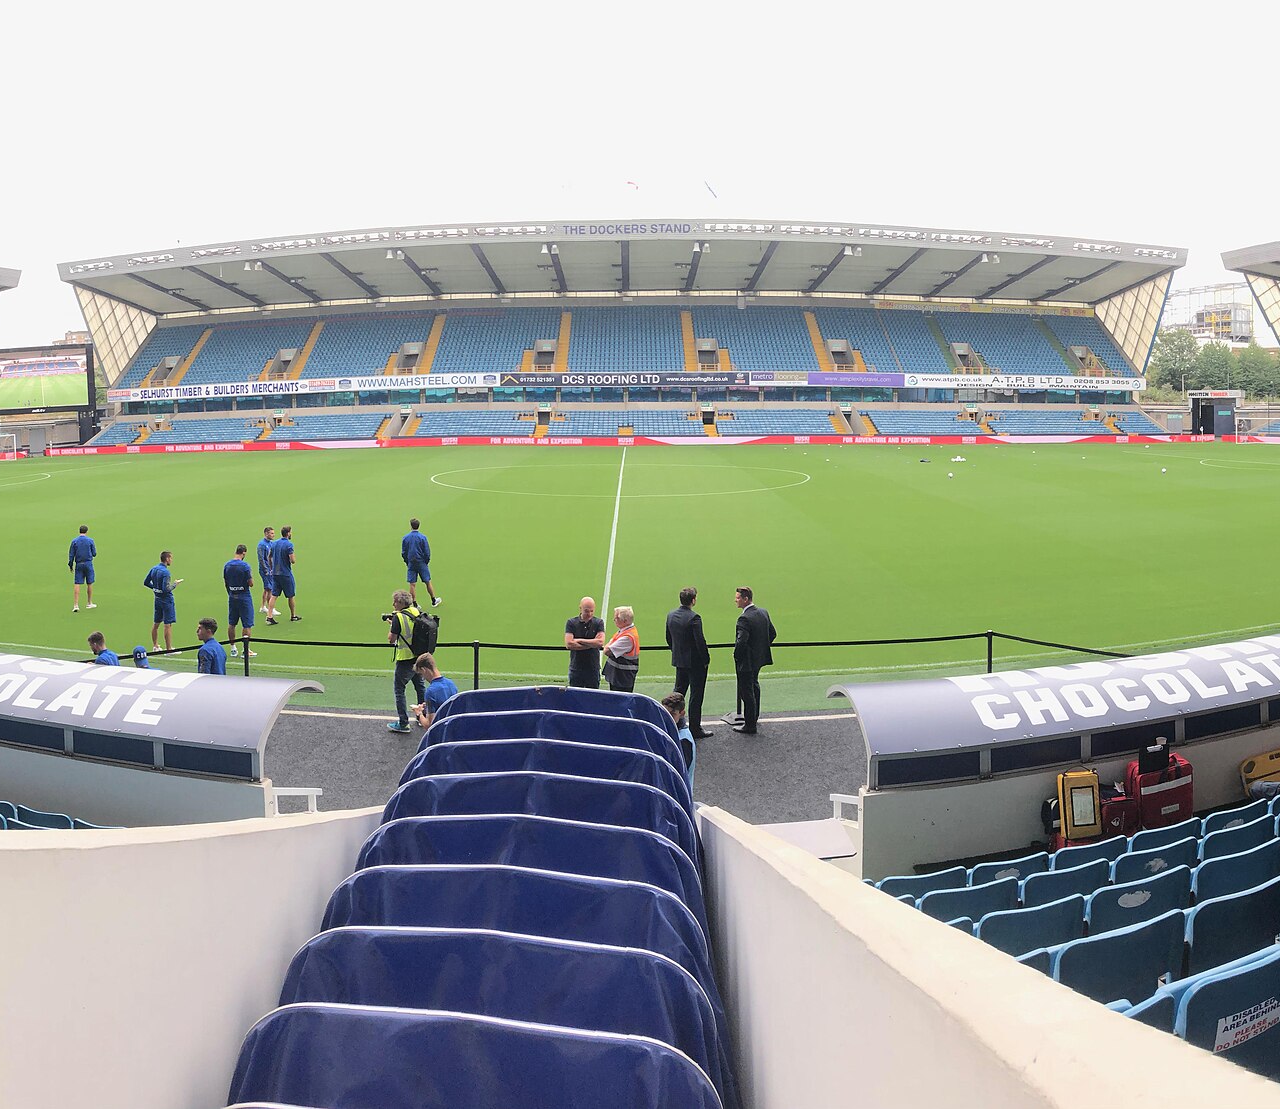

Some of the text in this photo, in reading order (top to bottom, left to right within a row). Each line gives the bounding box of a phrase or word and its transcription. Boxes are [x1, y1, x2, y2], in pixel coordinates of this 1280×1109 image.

[563, 223, 691, 235] THE DOCKERS STAND
[357, 375, 477, 388] WWW.MAHSTEEL.COM
[561, 374, 660, 384] DCS ROOFING LTD
[752, 373, 773, 381] metro
[992, 376, 1064, 384] A.T.P.B LTD
[140, 388, 174, 400] SELHURST
[175, 387, 202, 397] TIMBER
[205, 386, 210, 395] &
[214, 384, 249, 395] BUILDERS
[251, 382, 300, 393] MERCHANTS
[550, 437, 583, 445] EXPEDITION
[901, 436, 931, 444] EXPEDITION
[1232, 997, 1276, 1022] DISABLED
[1222, 1018, 1248, 1034] AREA
[1234, 1017, 1268, 1039] PLEASE
[1215, 1016, 1280, 1051] DO NOT STAND
